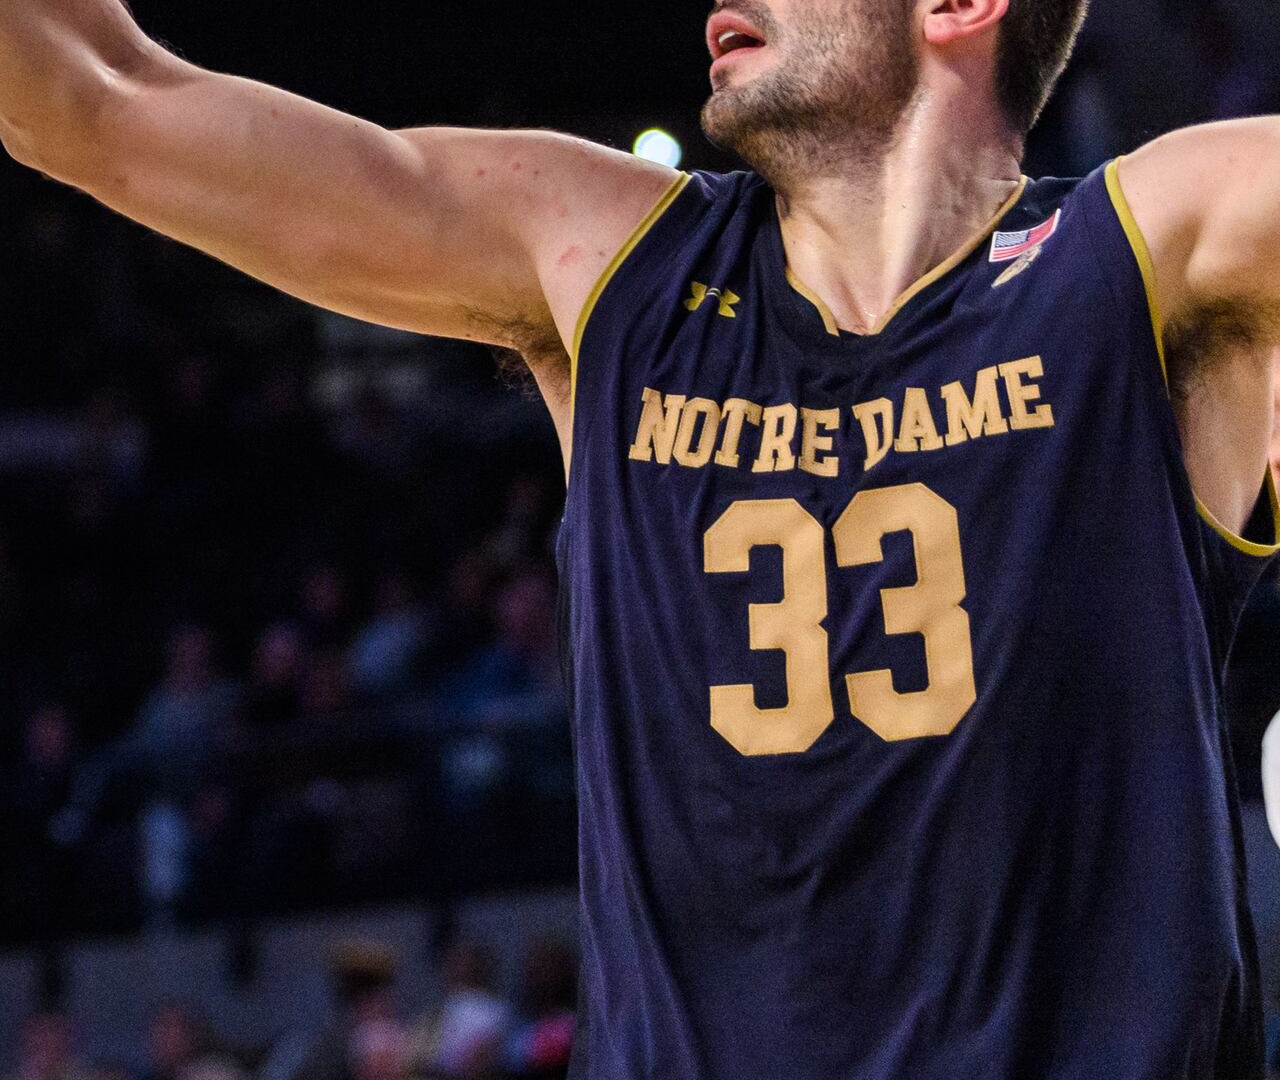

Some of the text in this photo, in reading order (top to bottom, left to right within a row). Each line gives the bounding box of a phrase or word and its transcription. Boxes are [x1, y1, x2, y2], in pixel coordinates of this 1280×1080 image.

[628, 355, 1055, 477] NOTRE DAME
[703, 482, 977, 756] 33
